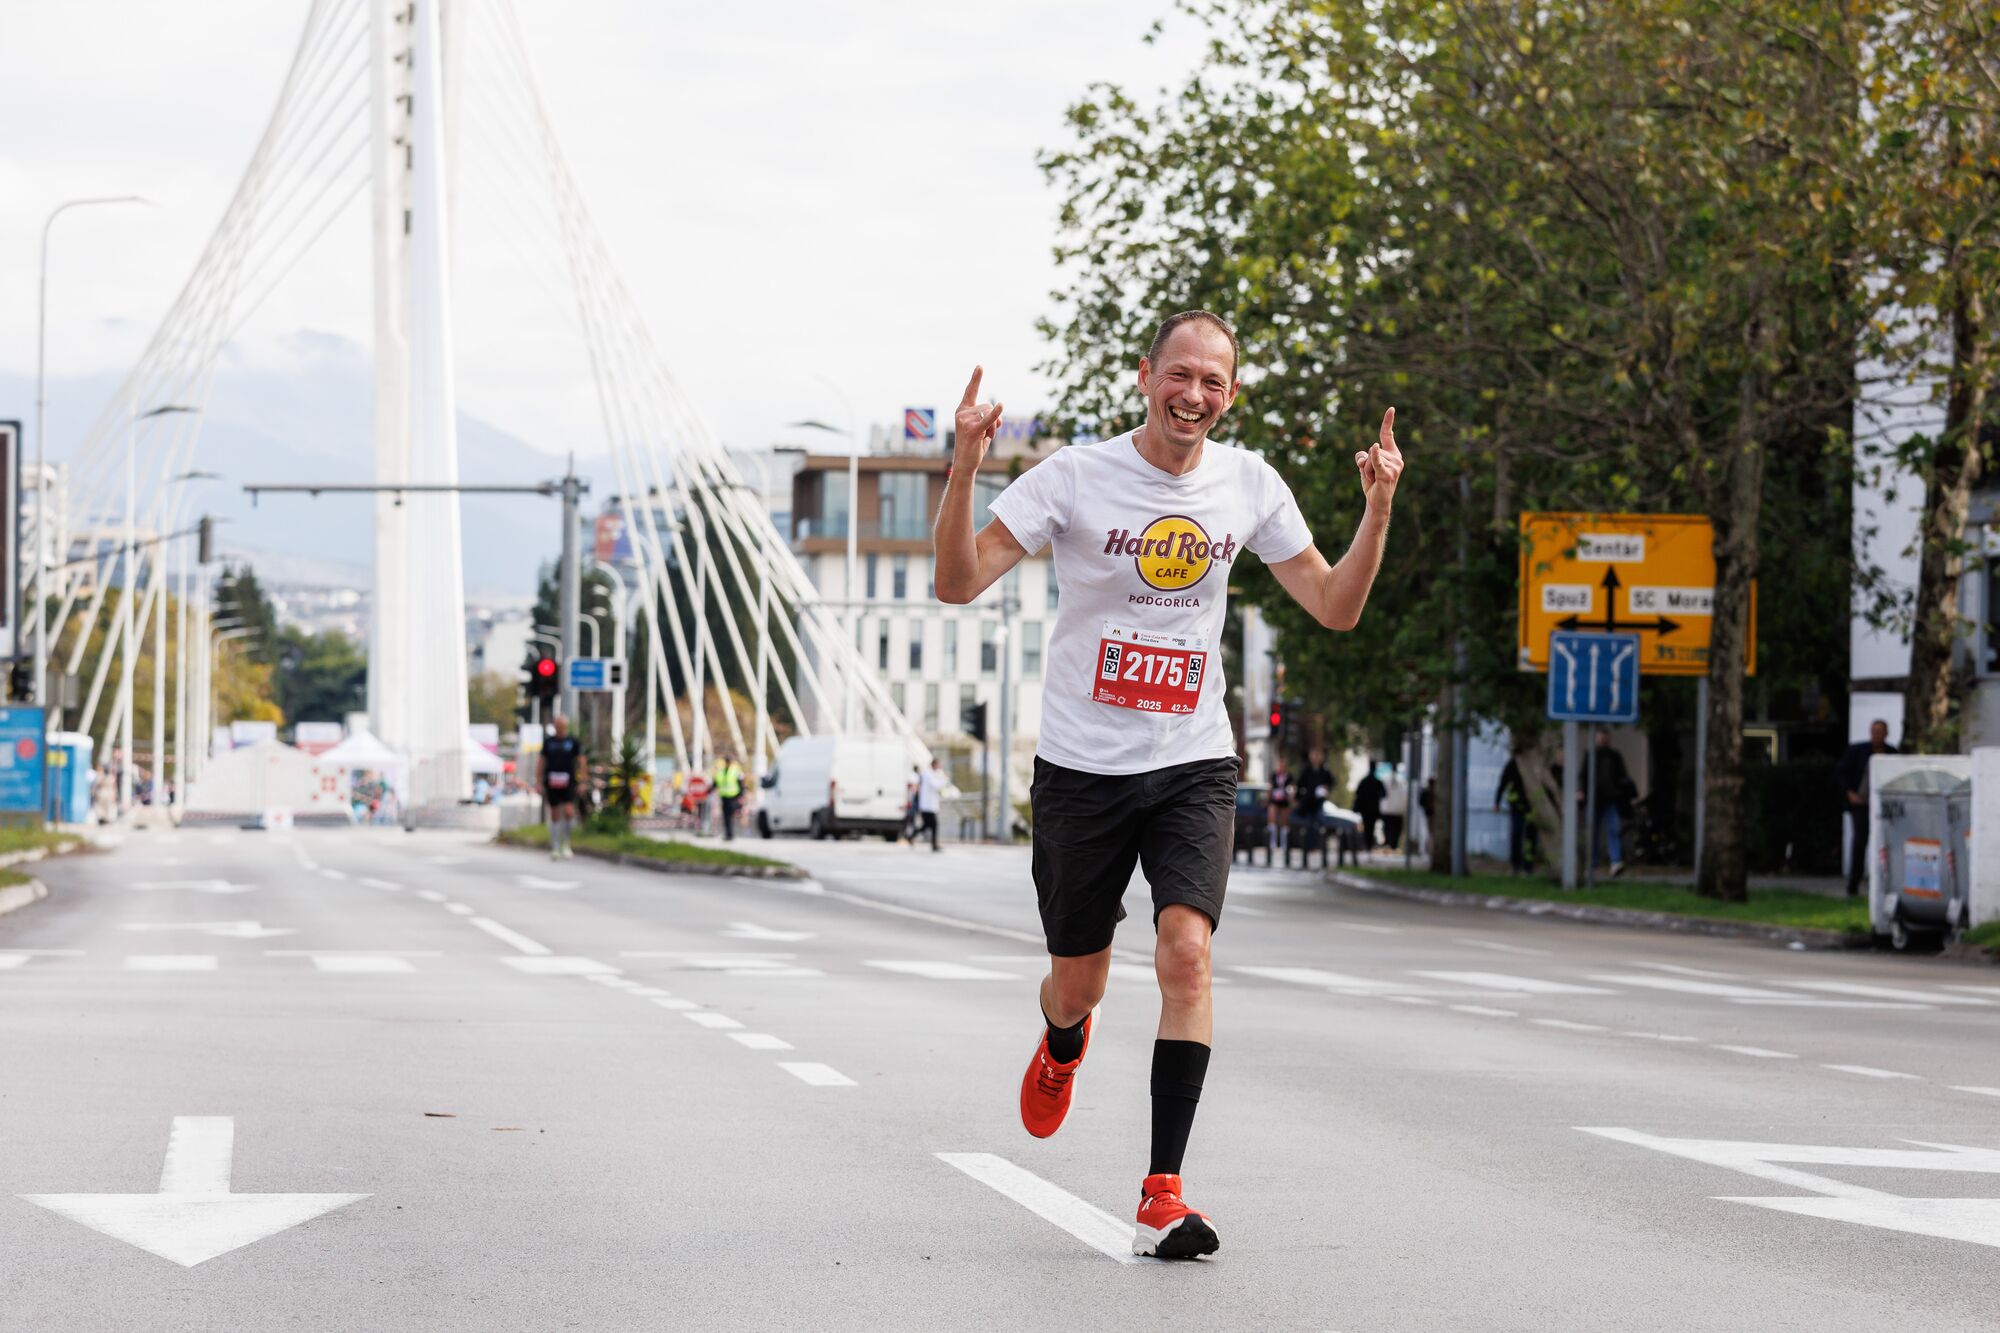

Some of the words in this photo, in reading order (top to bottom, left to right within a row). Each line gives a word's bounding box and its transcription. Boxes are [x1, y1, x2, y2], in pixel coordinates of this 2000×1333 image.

[1104, 529, 1176, 559] Hard
[1176, 532, 1236, 566] Rock
[1155, 568, 1188, 579] CAFE
[1128, 594, 1200, 608] PODGORICA
[1633, 590, 1656, 608] SC
[1667, 592, 1713, 608] Mora
[1123, 651, 1184, 687] 2175
[1136, 699, 1162, 711] 2025
